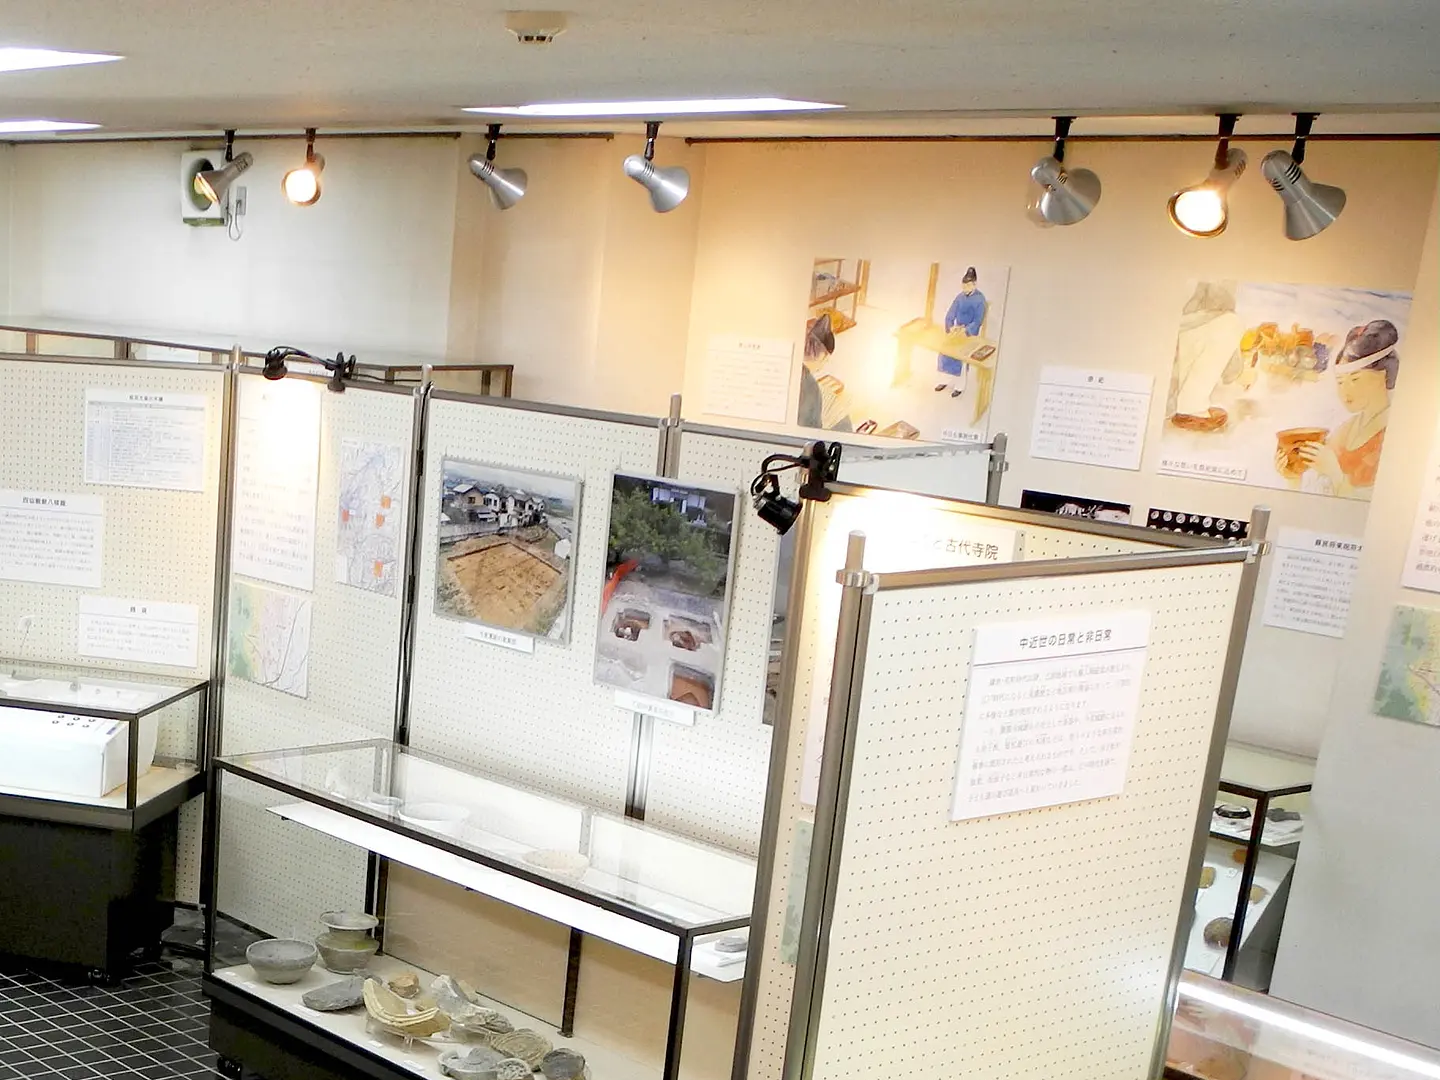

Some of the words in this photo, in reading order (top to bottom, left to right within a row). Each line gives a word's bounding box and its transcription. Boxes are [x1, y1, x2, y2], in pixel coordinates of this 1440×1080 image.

[1019, 629, 1112, 650] 中近世の日常と非日常
